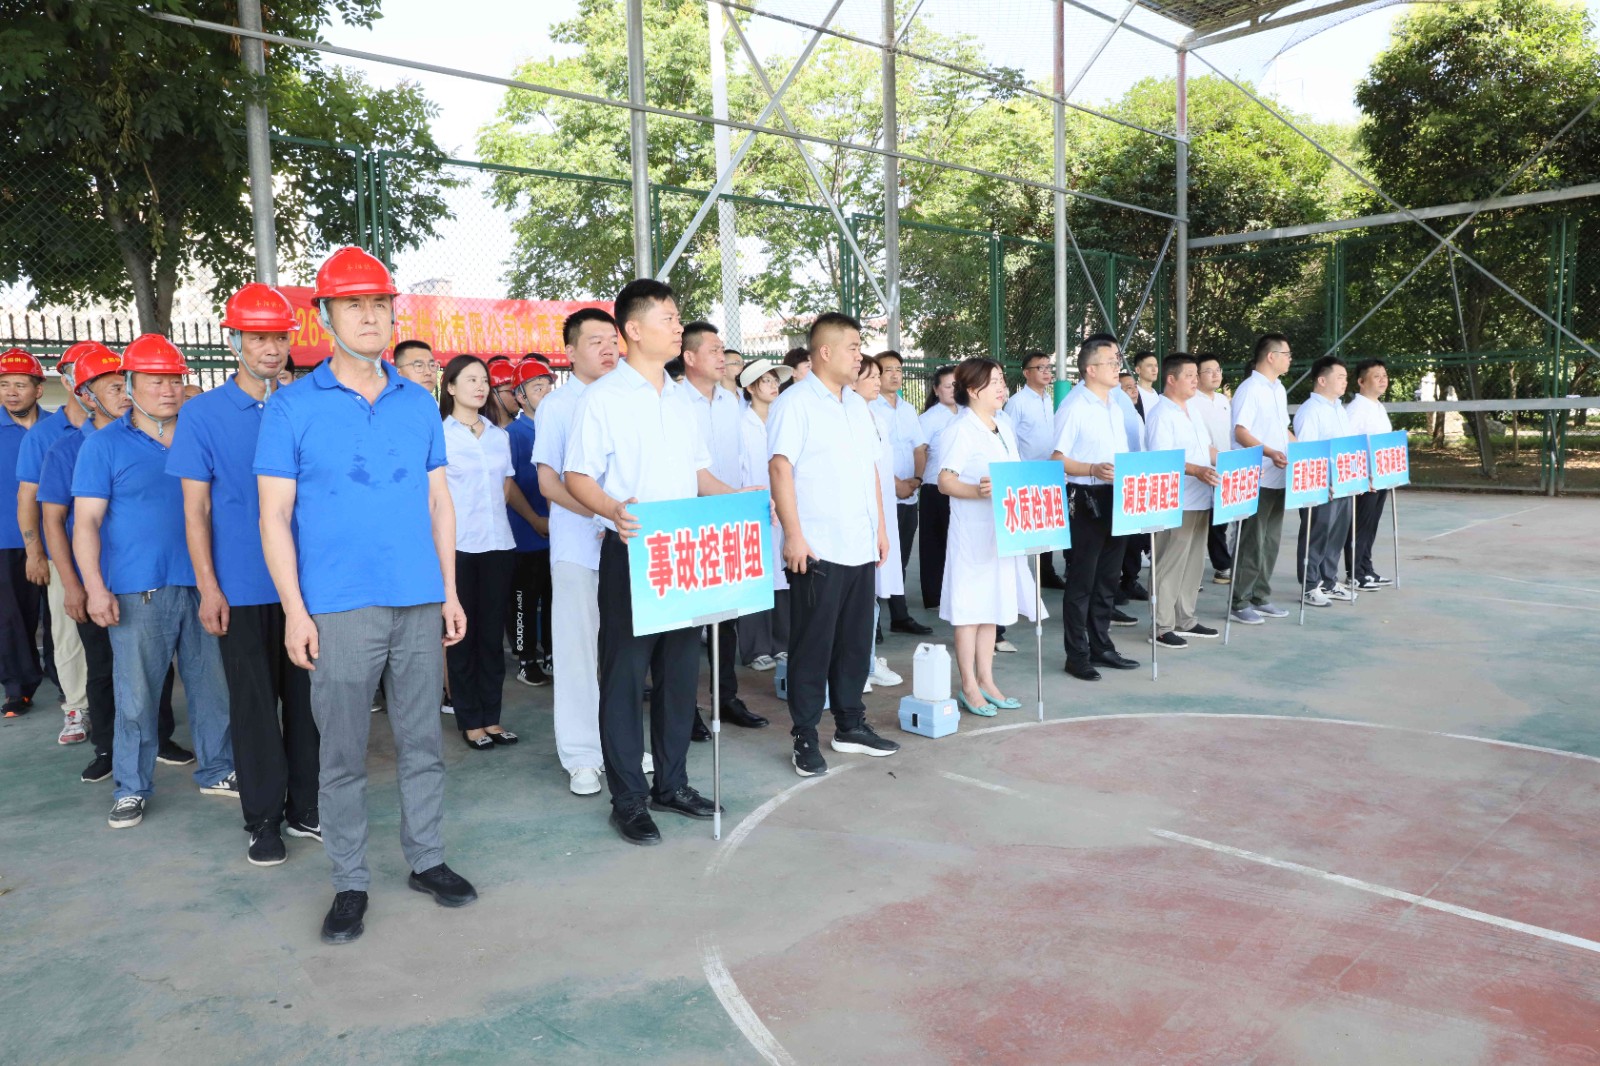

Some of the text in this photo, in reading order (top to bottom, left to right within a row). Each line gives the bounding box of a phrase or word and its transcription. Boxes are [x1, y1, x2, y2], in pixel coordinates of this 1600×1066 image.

[1122, 473, 1180, 514] 调度调配组
[1292, 459, 1328, 492] 后勤保障组
[1003, 486, 1065, 533] 水质检测组
[646, 521, 764, 598] 事故控制组
[516, 612, 525, 652] balance
